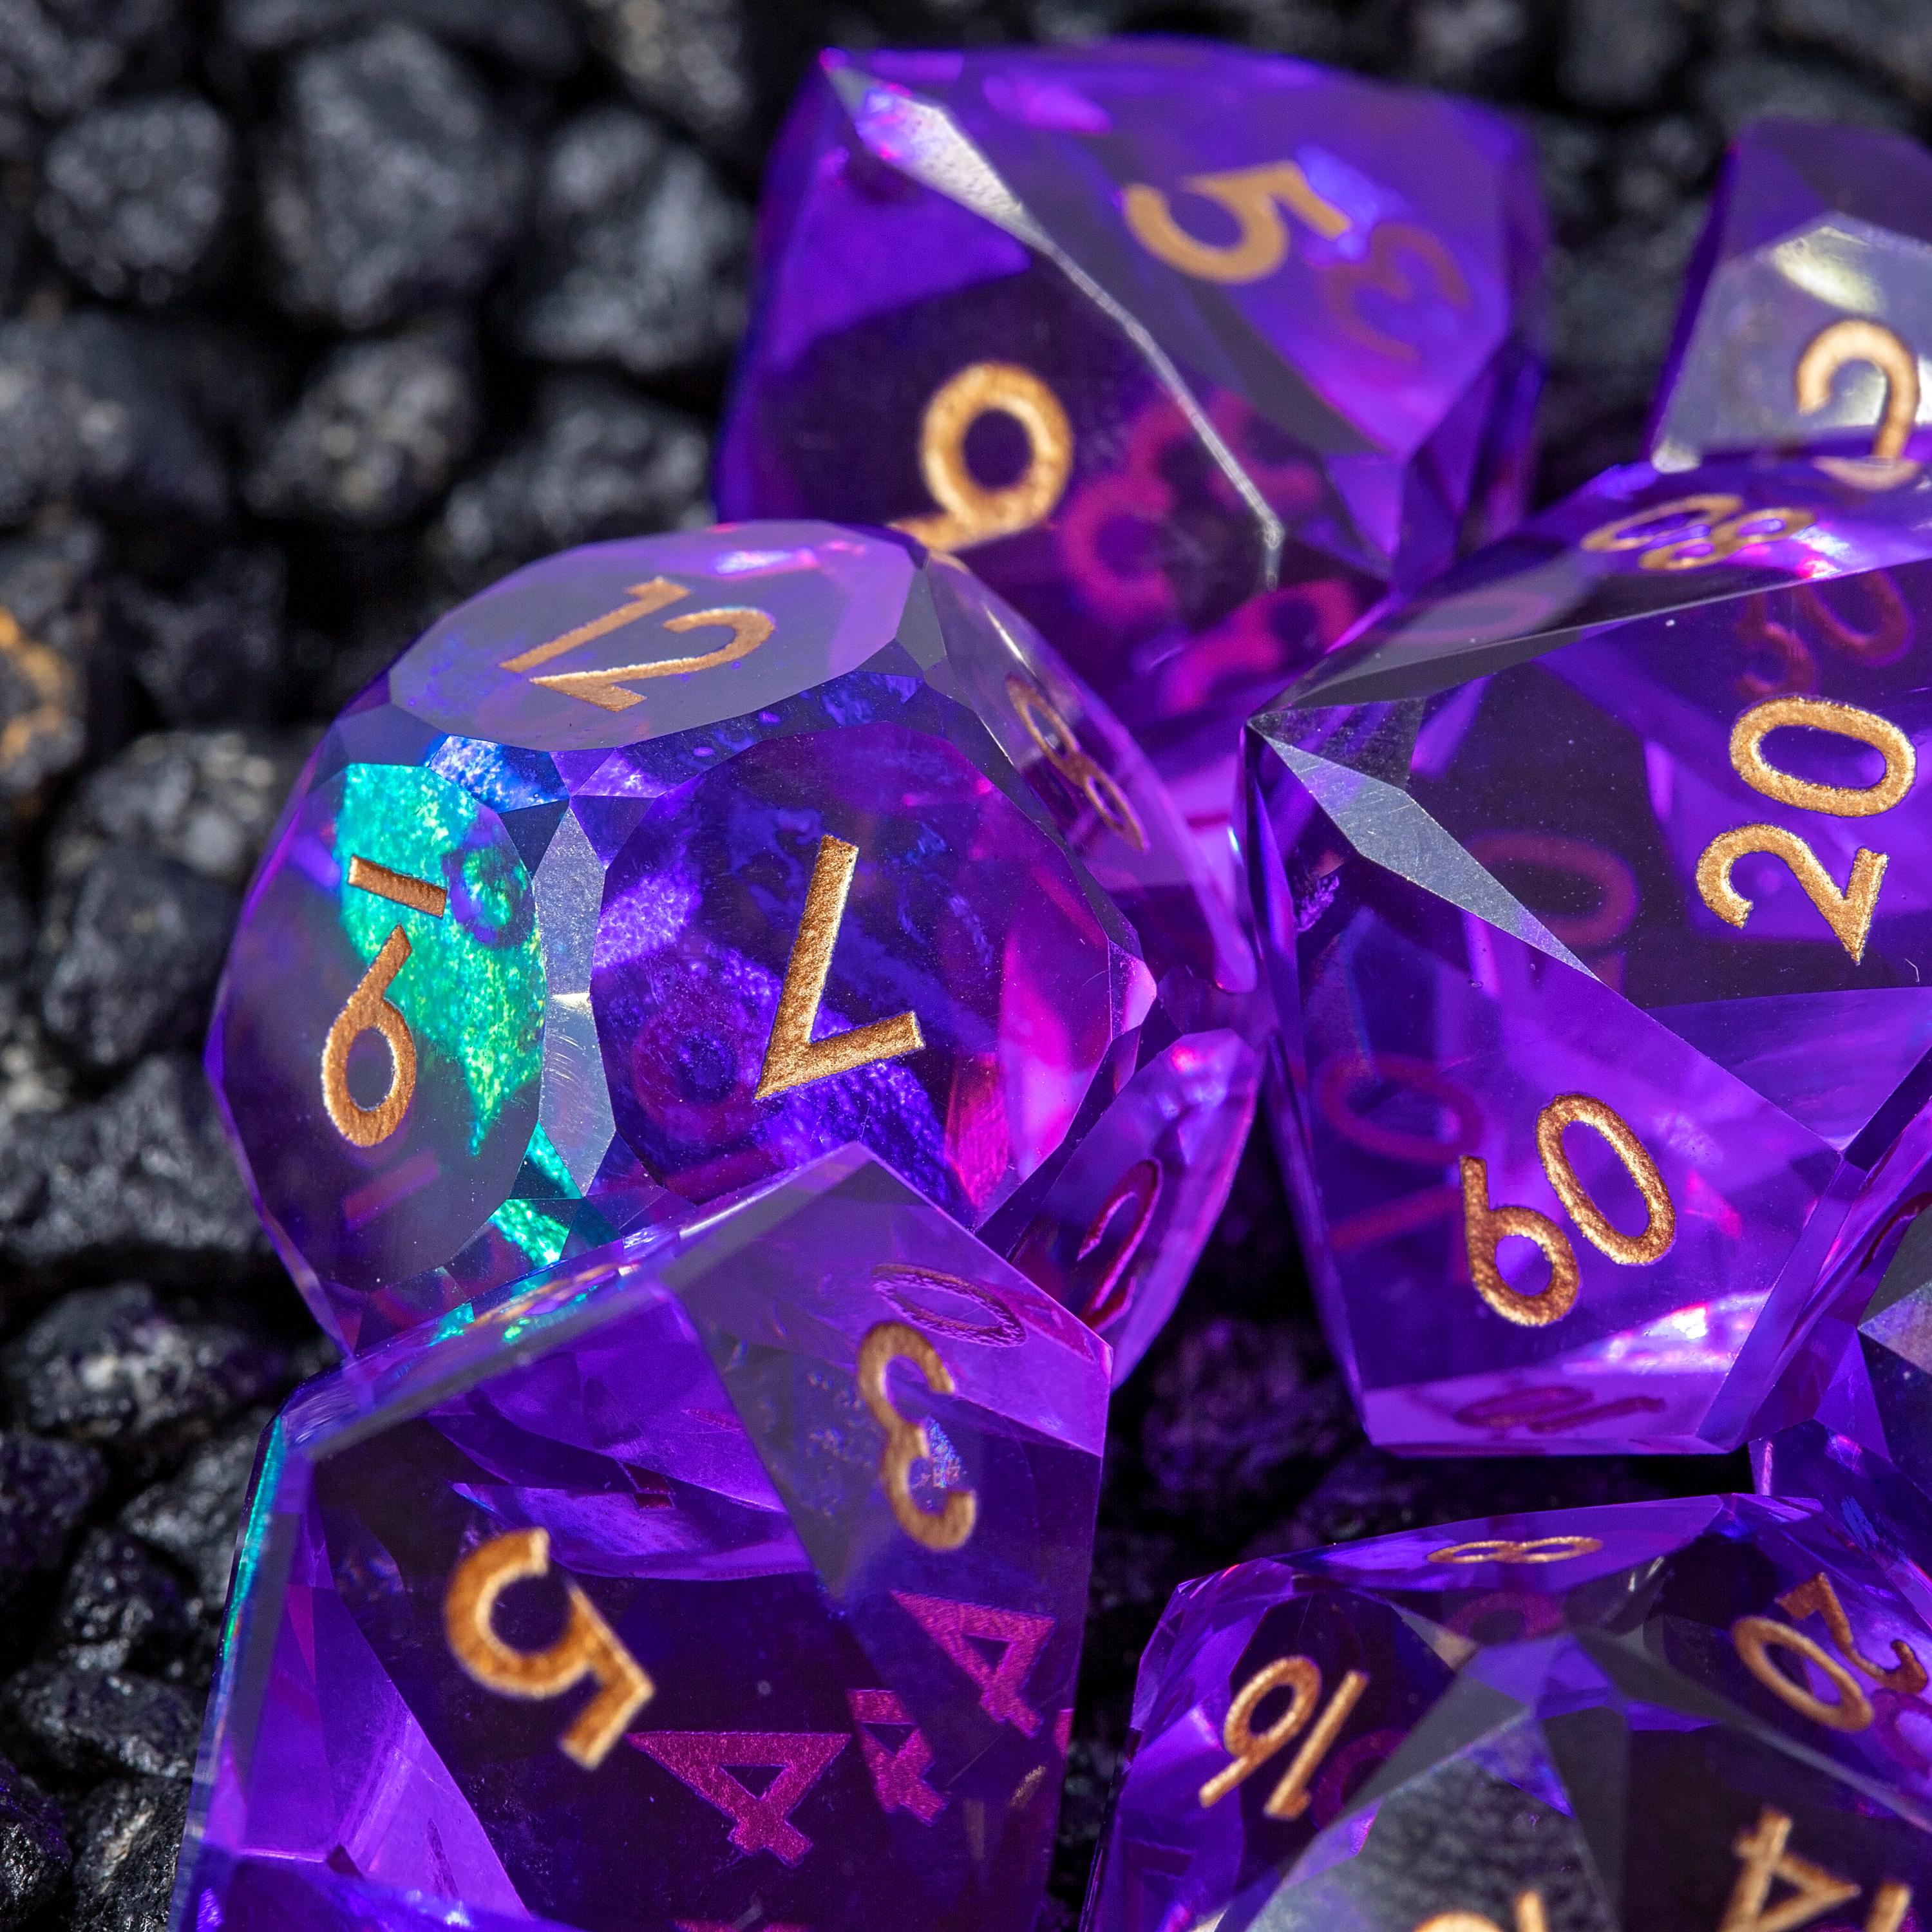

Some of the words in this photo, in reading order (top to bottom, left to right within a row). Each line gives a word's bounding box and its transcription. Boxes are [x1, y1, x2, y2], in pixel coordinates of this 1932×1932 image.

[1124, 161, 1351, 283] 5
[500, 576, 775, 713] 12
[1007, 673, 1150, 851] 8
[1696, 696, 1917, 966] 20
[753, 835, 925, 1101] 7
[1459, 1093, 1676, 1327] 60
[858, 1321, 976, 1551] 3
[1426, 1536, 1604, 1564] 8
[443, 1526, 654, 1769] 5
